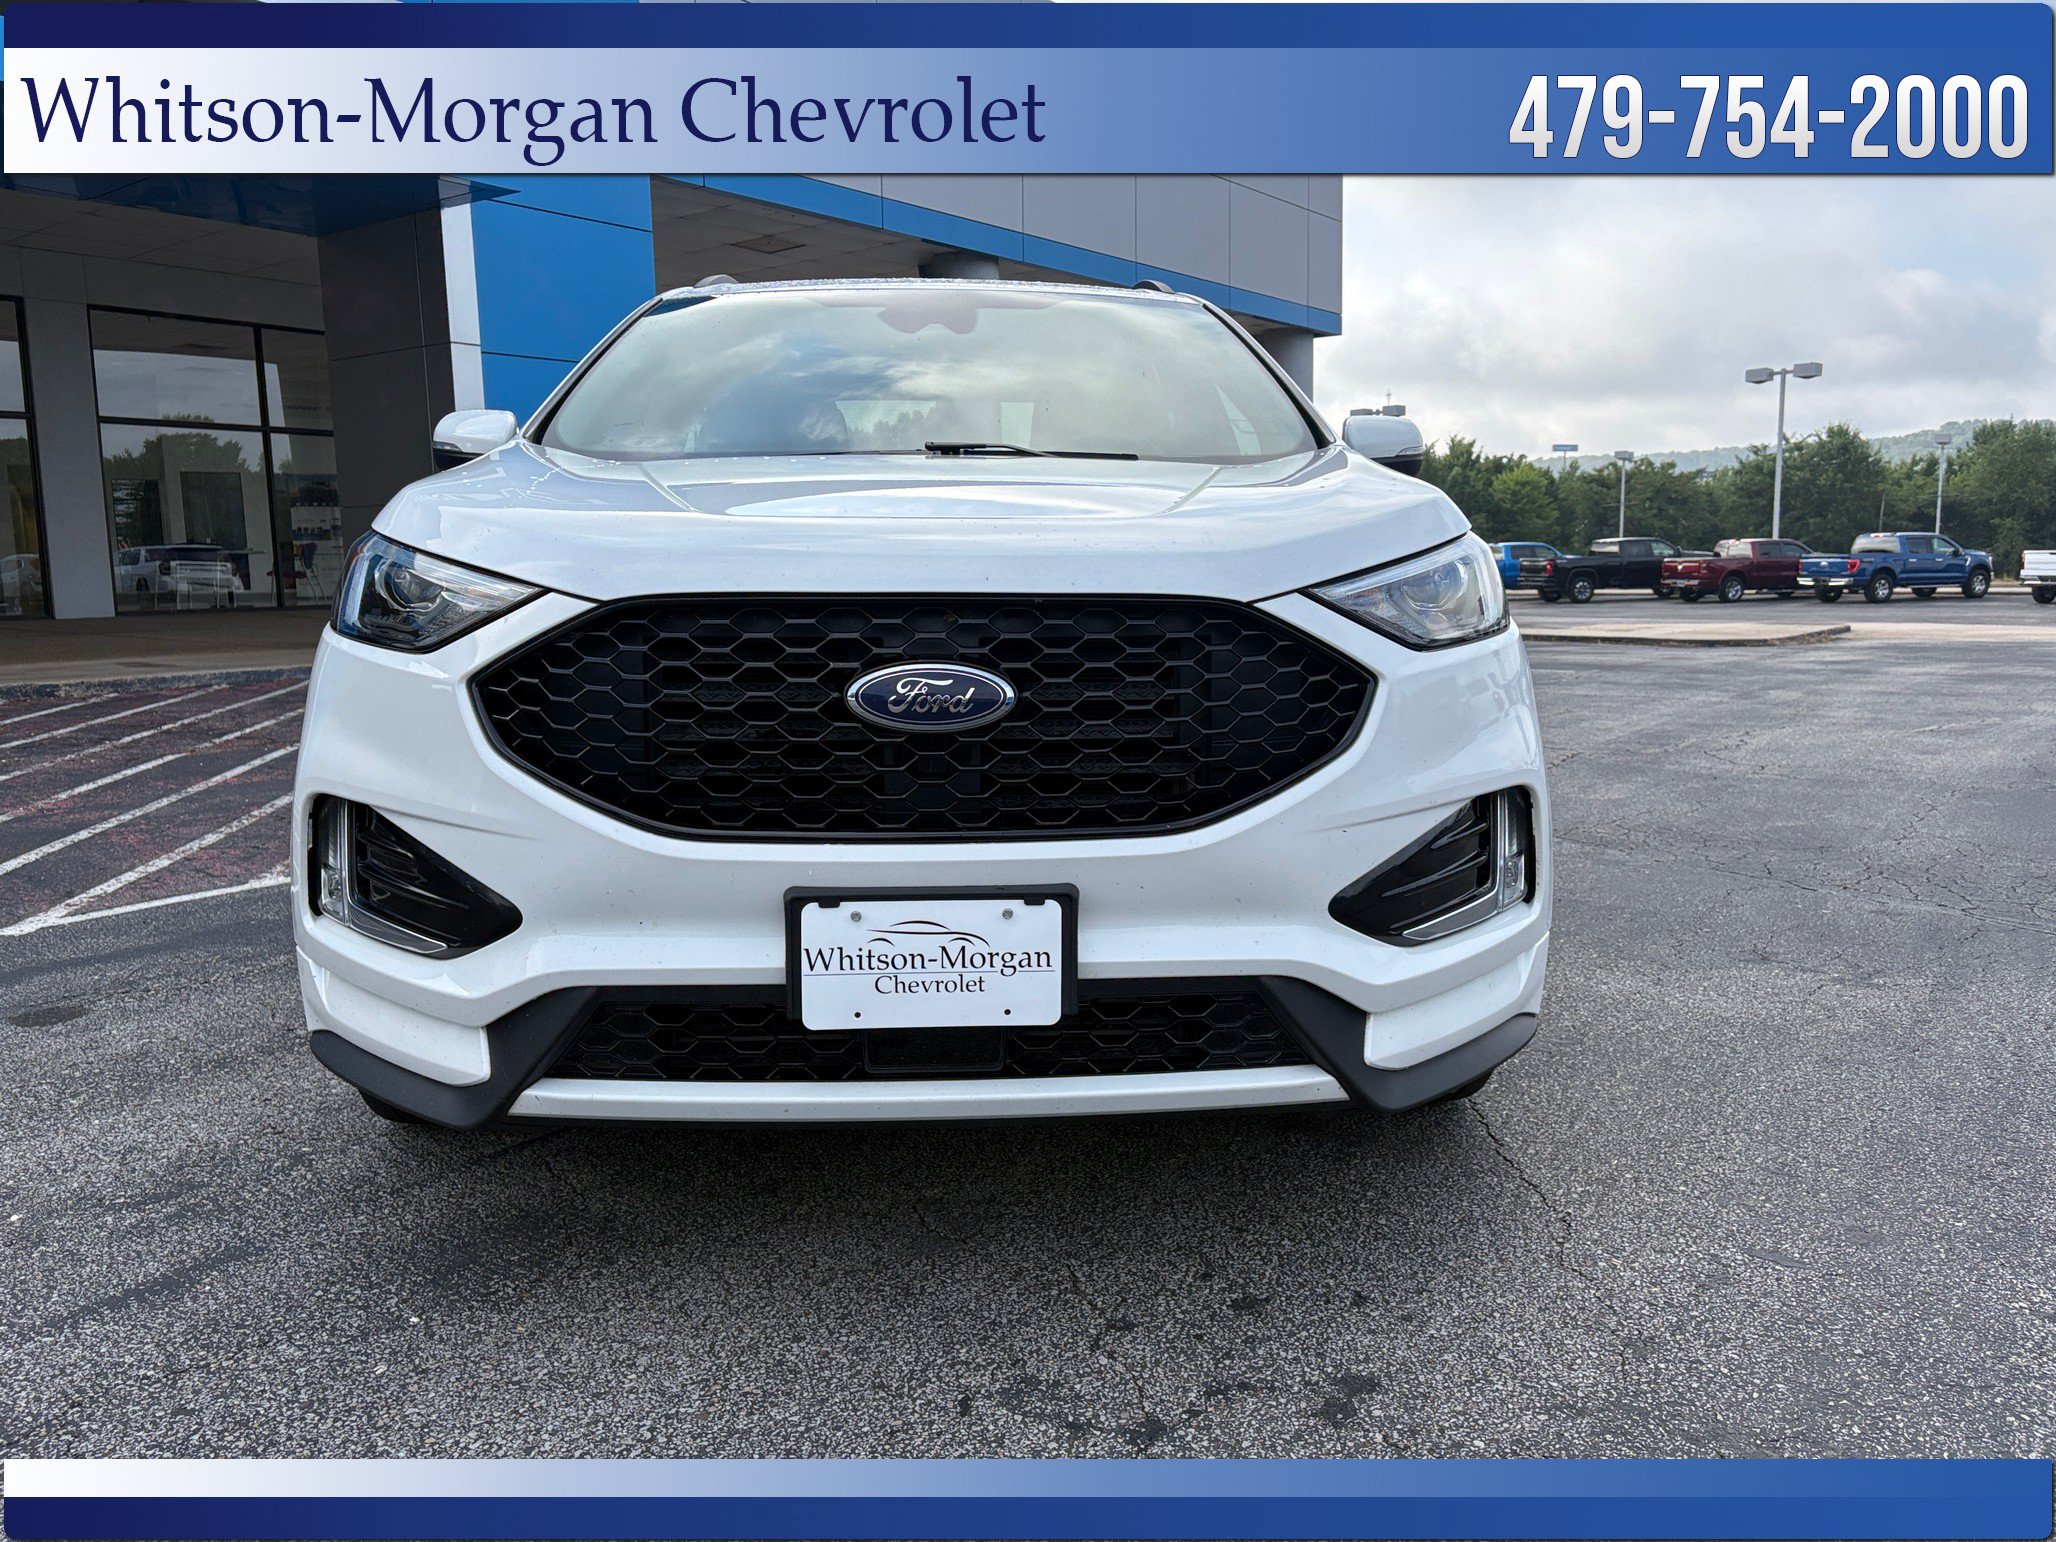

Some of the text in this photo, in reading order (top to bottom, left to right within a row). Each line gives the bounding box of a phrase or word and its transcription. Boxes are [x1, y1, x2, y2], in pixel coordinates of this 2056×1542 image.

[887, 677, 976, 714] Ford
[803, 945, 1053, 977] Whitson-Morgan
[874, 973, 986, 995] Chevrolet
